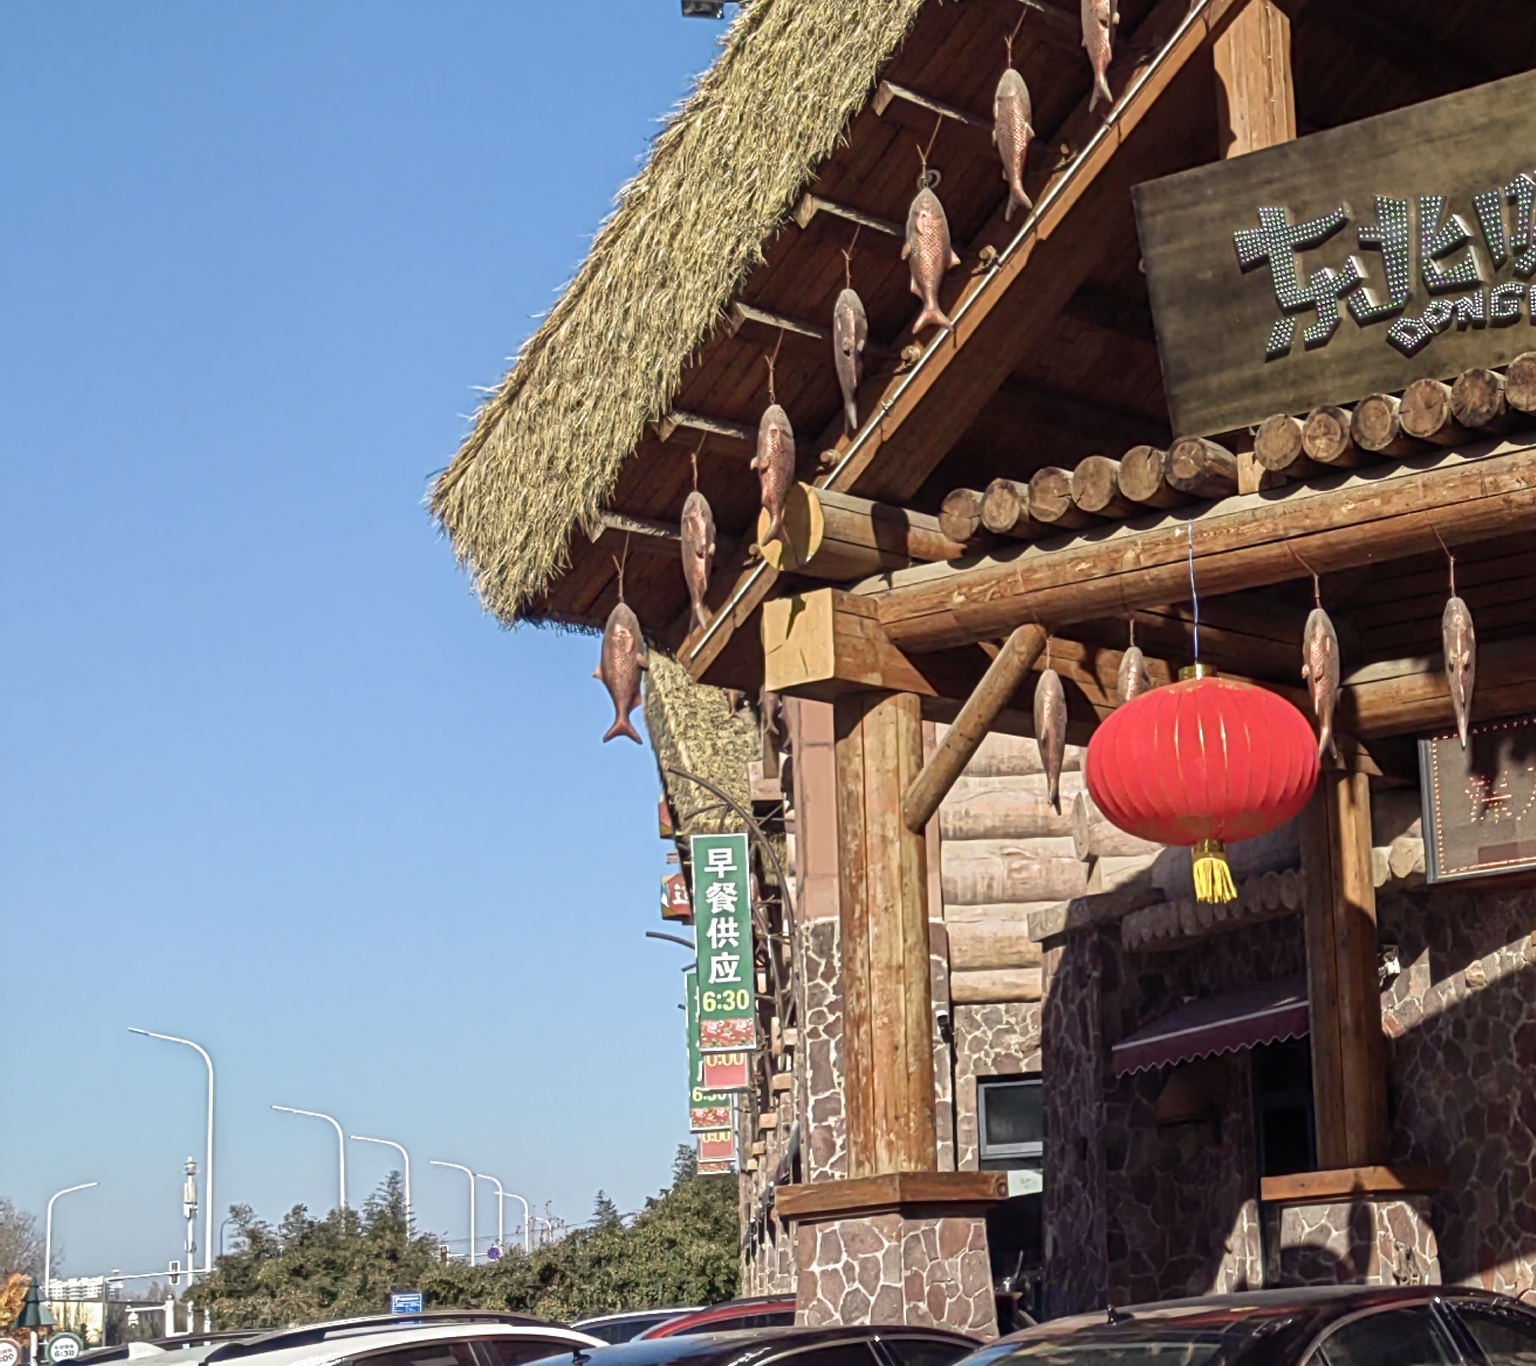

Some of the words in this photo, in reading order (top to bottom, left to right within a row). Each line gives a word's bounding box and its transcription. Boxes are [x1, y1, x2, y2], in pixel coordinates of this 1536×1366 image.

[704, 847, 741, 984] 早餐供应
[702, 989, 750, 1012] 6:30
